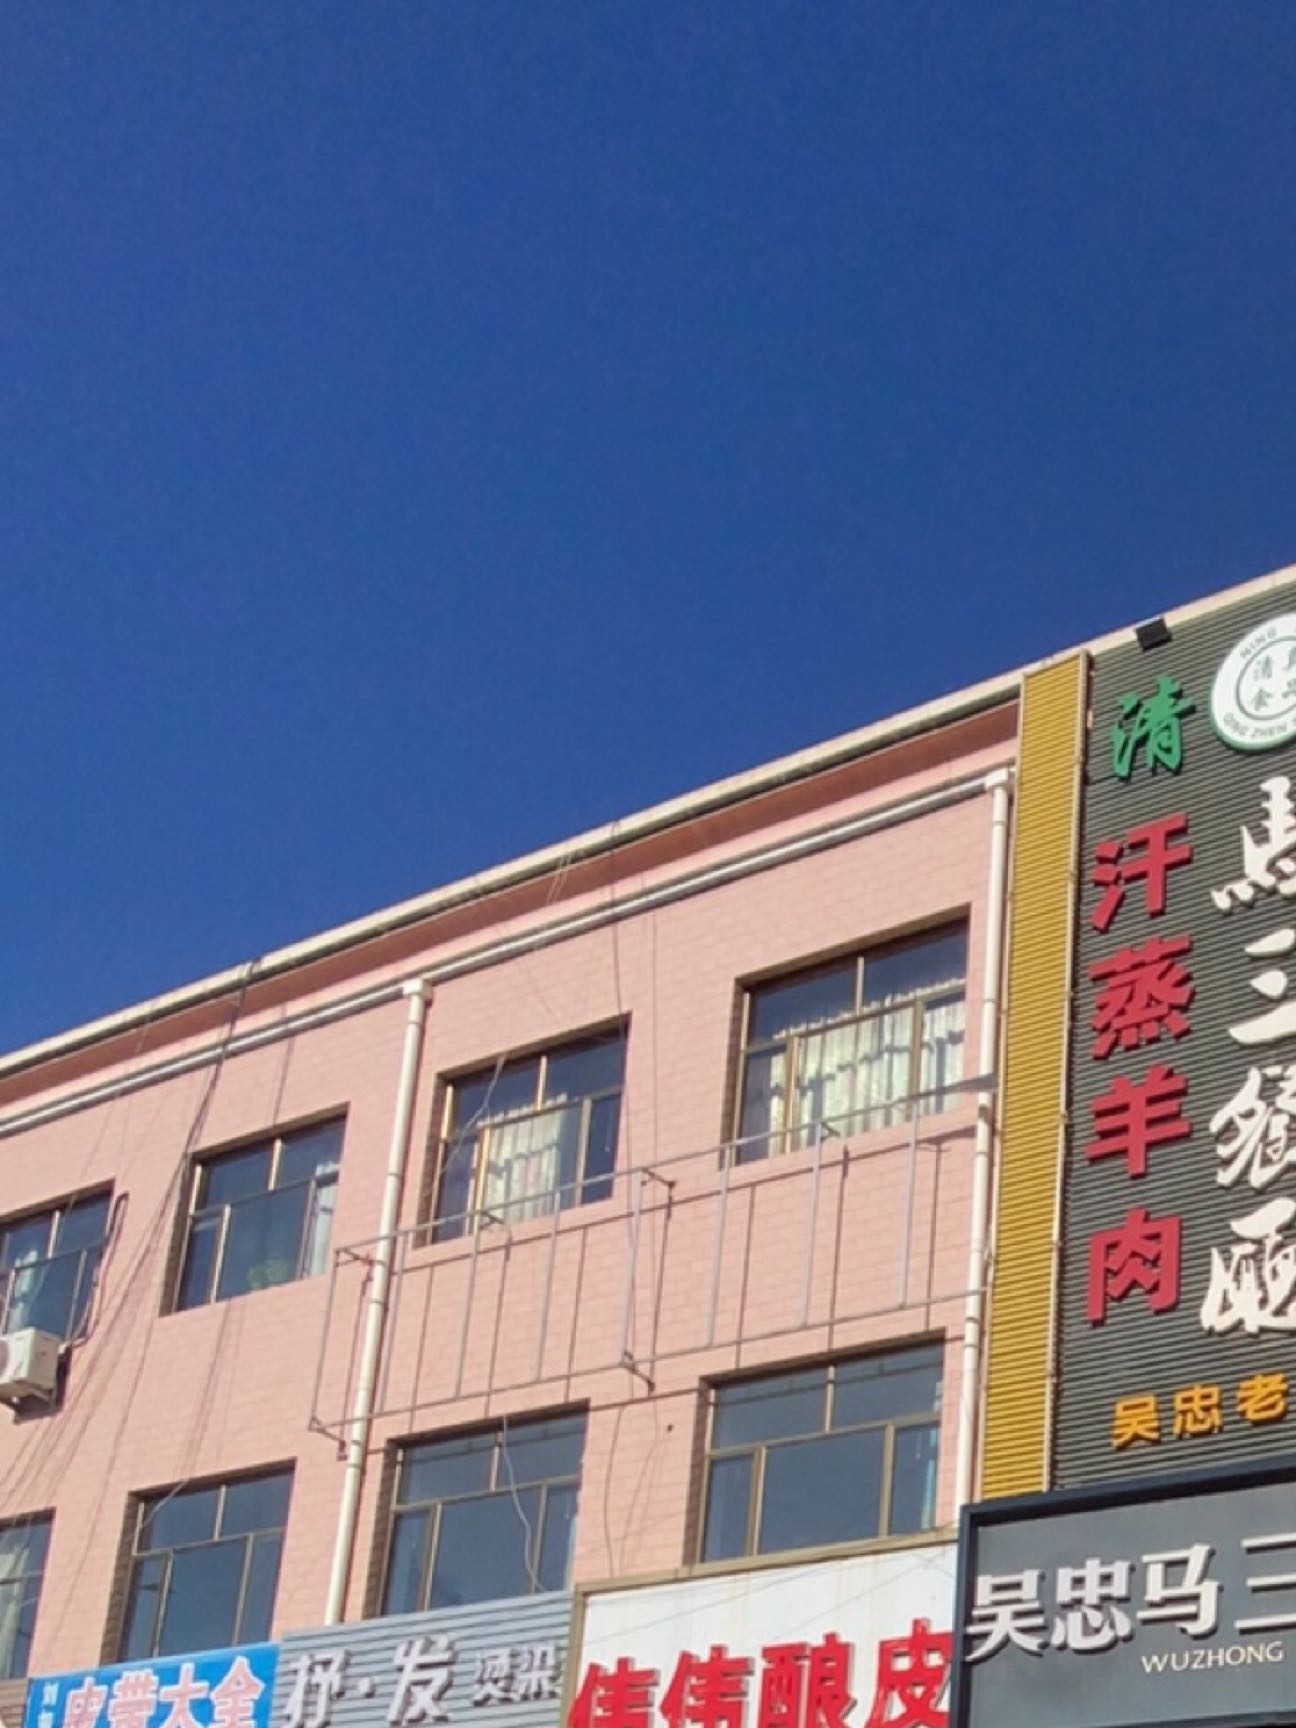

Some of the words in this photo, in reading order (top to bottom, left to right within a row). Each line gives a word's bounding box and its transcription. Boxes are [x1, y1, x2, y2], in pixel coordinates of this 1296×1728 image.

[1111, 674, 1195, 780] 清
[1082, 811, 1194, 1326] 汗蒸羊肉
[1141, 1640, 1285, 1675] WUZHONG
